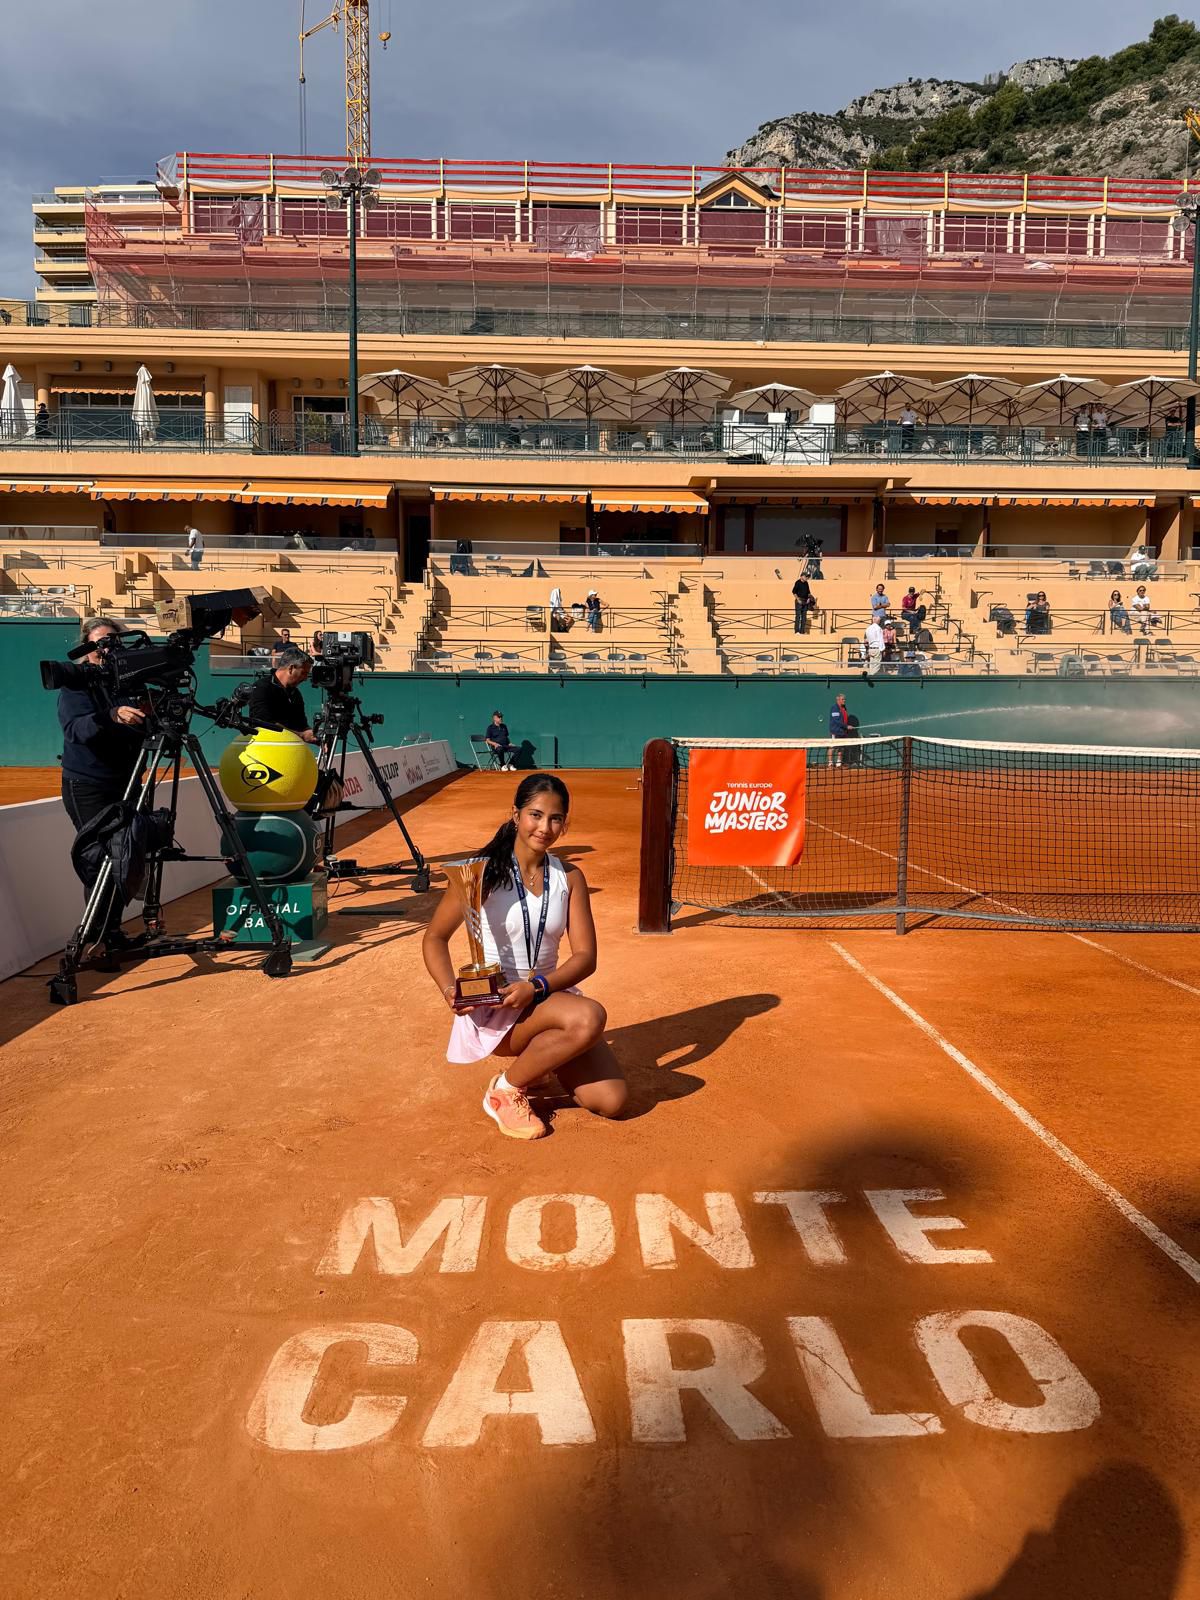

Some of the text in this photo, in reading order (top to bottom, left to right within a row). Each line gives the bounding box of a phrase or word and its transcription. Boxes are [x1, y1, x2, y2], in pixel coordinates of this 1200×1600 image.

[342, 776, 363, 799] NDA
[704, 811, 789, 834] MASTERS
[315, 1187, 996, 1276] MONTE
[244, 1309, 1102, 1452] CARLO
